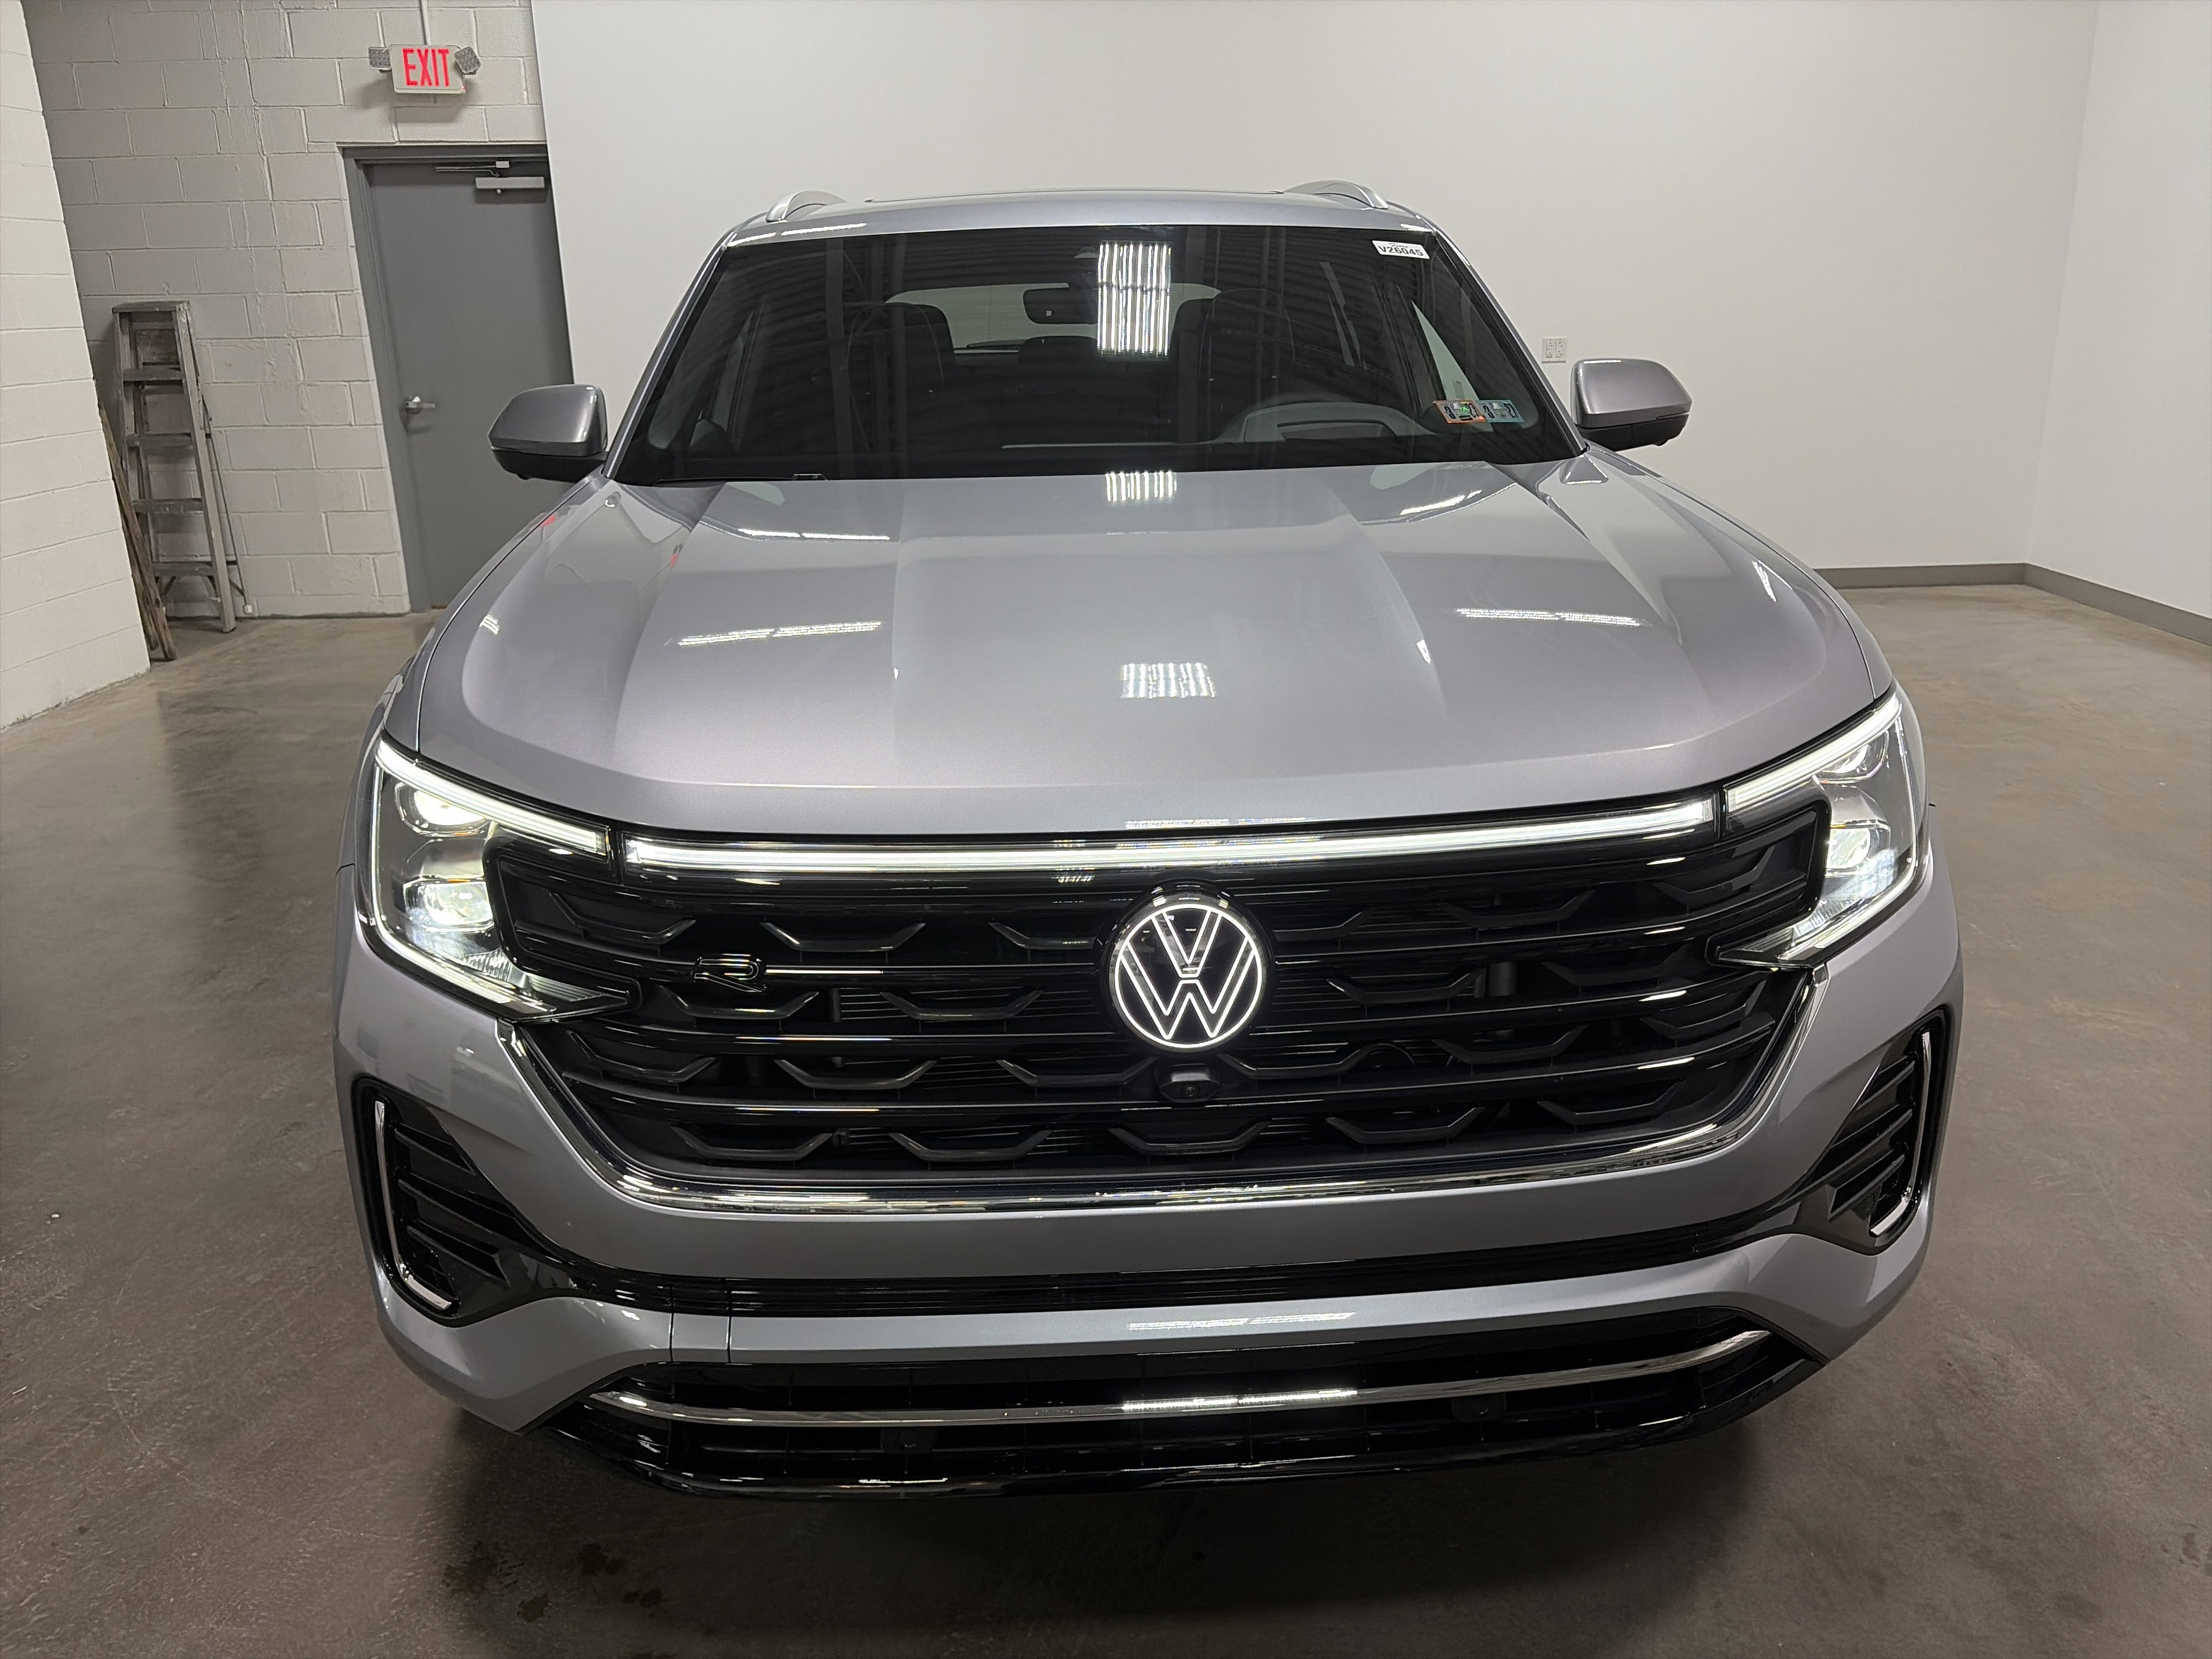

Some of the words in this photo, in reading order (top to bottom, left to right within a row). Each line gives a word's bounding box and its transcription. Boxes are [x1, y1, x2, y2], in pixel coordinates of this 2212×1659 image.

[402, 48, 450, 87] EXIT
[1378, 246, 1424, 256] V26045
[1444, 406, 1456, 419] 3
[1482, 405, 1495, 419] 3
[1503, 403, 1519, 419] 27
[1118, 906, 1257, 1041] VW
